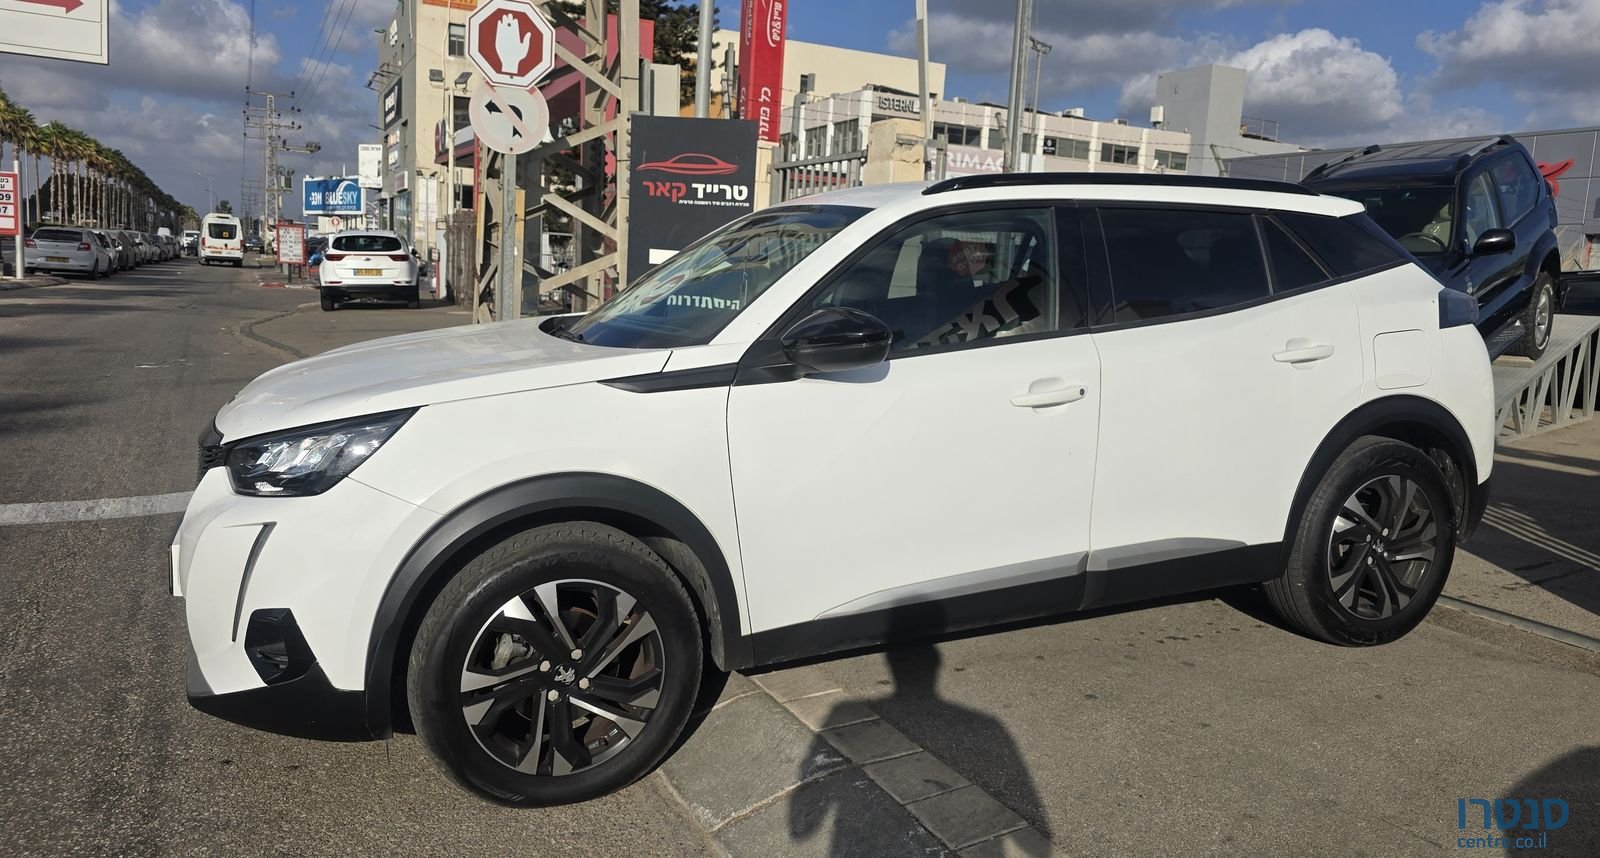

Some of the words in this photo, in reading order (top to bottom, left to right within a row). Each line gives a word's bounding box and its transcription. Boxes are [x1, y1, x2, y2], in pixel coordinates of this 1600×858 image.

[759, 87, 771, 102] כל
[643, 181, 687, 202] קאר
[691, 183, 748, 200] טרייד
